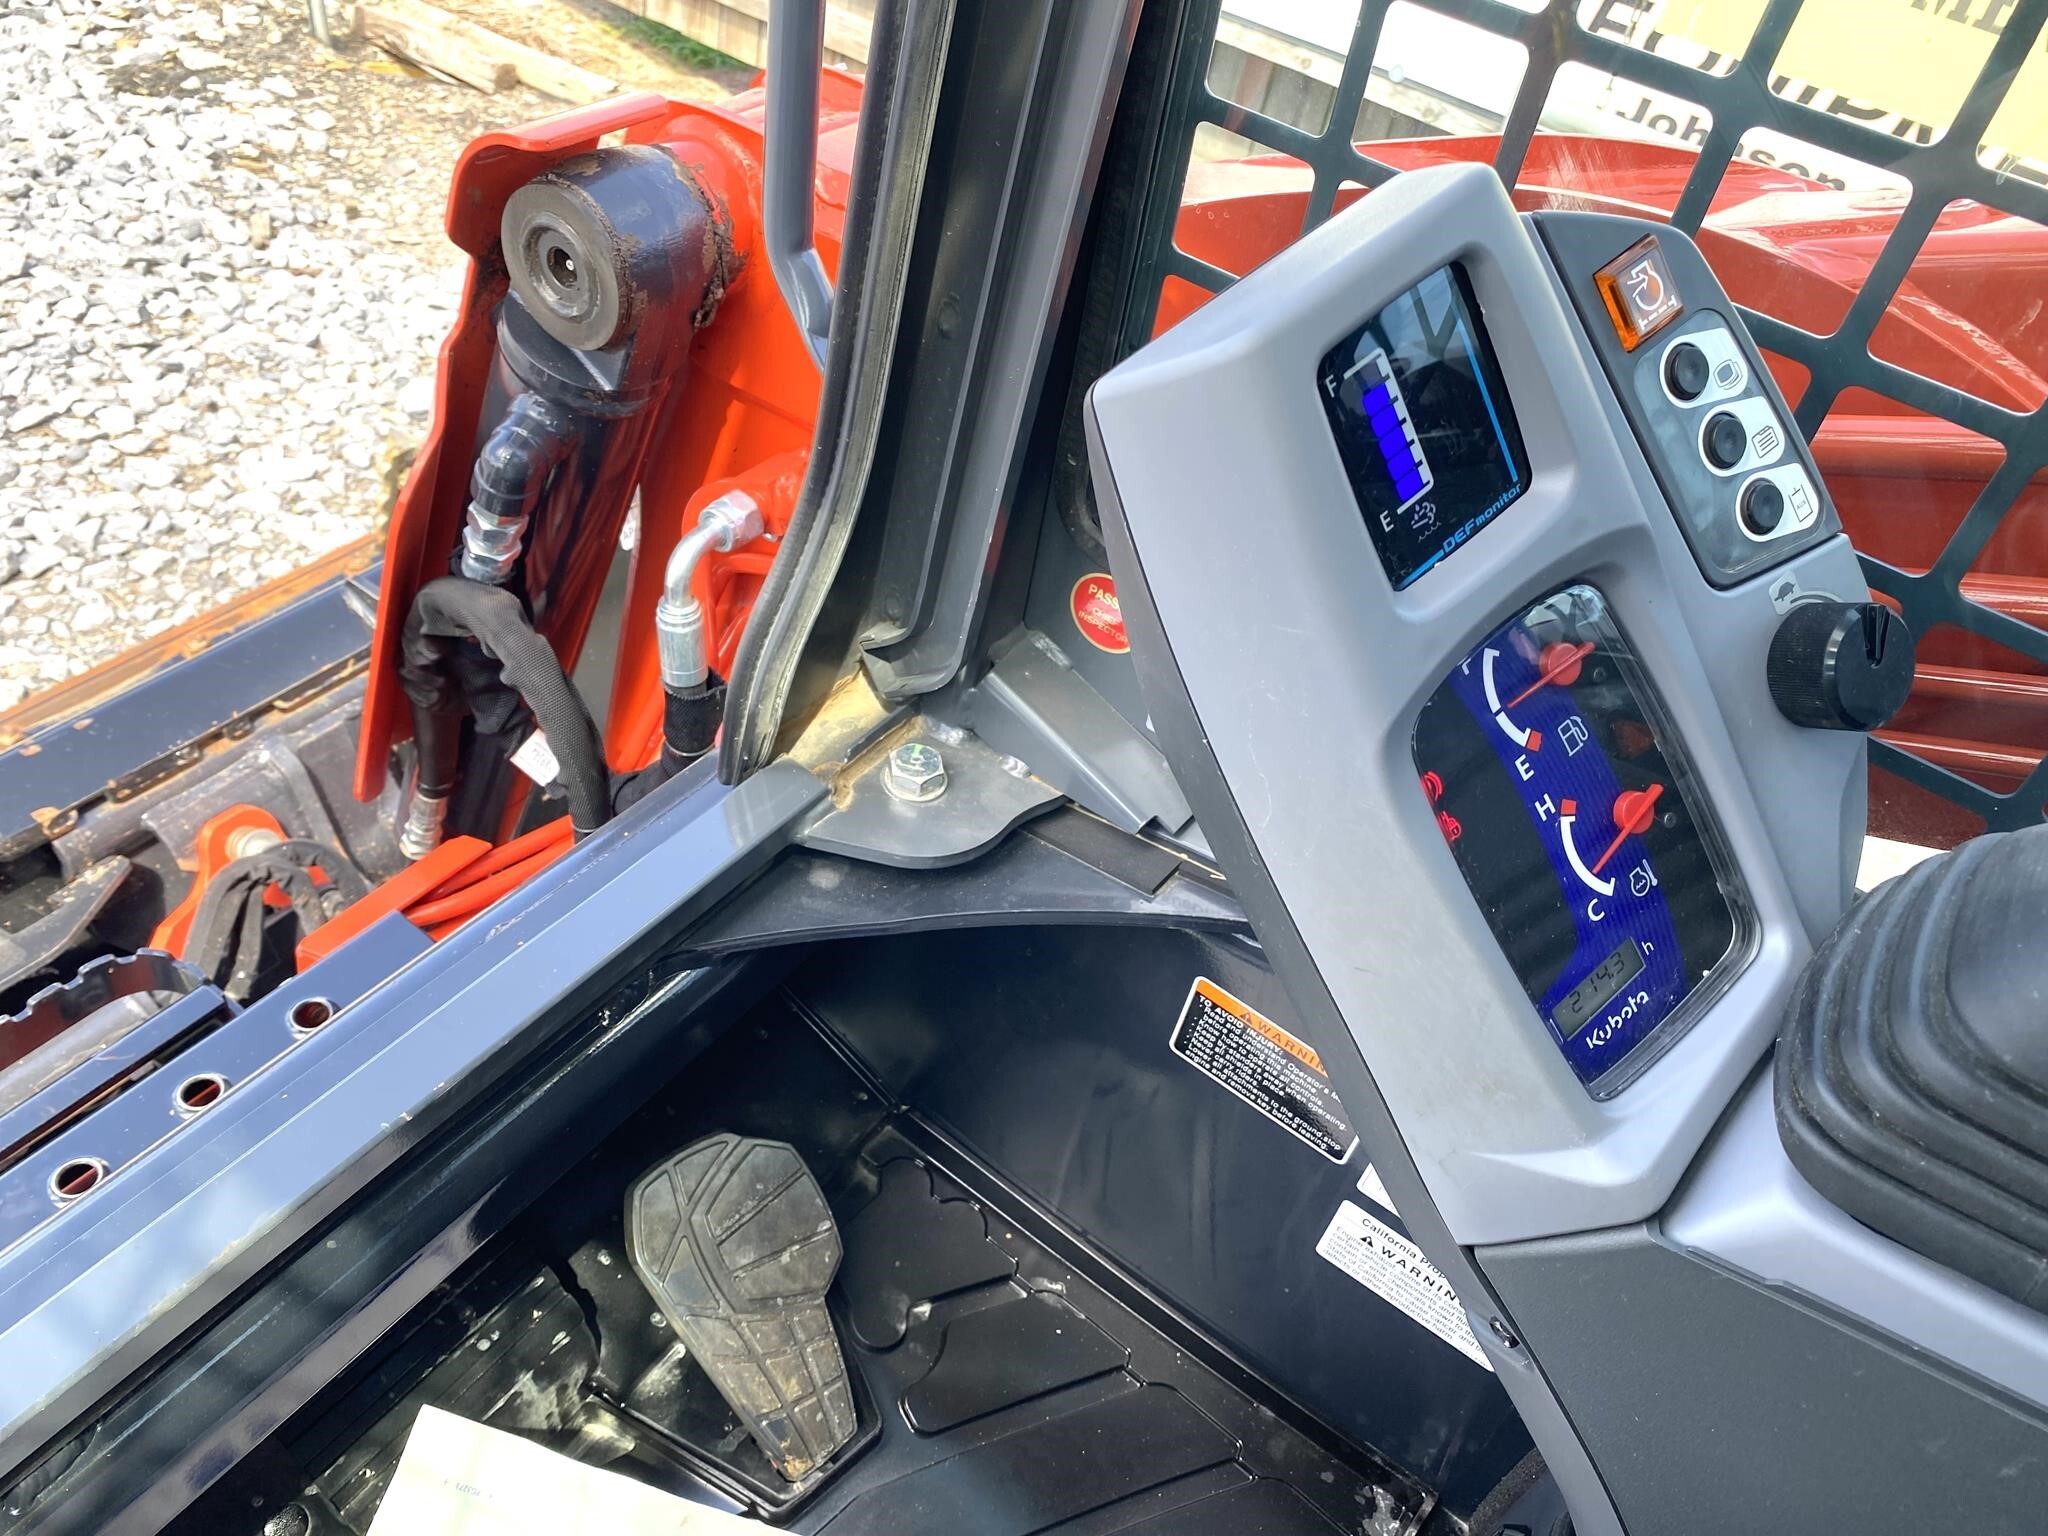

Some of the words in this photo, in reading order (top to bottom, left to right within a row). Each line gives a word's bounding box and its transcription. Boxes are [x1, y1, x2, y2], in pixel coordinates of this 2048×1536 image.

[1325, 374, 1337, 398] F
[1379, 510, 1394, 533] E
[1514, 754, 1535, 782] E
[1534, 793, 1556, 822] H
[1587, 898, 1605, 922] C
[1569, 952, 1625, 1014] 214.3
[1641, 941, 1655, 956] h
[1199, 995, 1211, 1007] TO
[1215, 1006, 1243, 1028] AVOID
[1247, 1027, 1282, 1055] INJURY:
[1203, 1014, 1227, 1034] before
[1229, 1032, 1265, 1060] operating
[1267, 1057, 1281, 1070] this
[1585, 991, 1650, 1050] Kubota
[1191, 1037, 1212, 1055] Never
[1214, 1054, 1233, 1070] carry
[1236, 1068, 1259, 1087] riders.
[1193, 1032, 1212, 1048] Keep
[1215, 1046, 1223, 1055] all
[1225, 1053, 1251, 1074] shields
[1254, 1073, 1261, 1081] in
[1263, 1079, 1285, 1098] place.
[1196, 1025, 1215, 1042] Keep
[1218, 1040, 1260, 1073] by-standers
[1263, 1071, 1283, 1089] away
[1285, 1085, 1306, 1103] when
[1307, 1101, 1347, 1132] operating.
[1199, 1019, 1219, 1036] Know
[1221, 1034, 1236, 1048] how
[1239, 1046, 1246, 1054] to
[1248, 1053, 1277, 1076] operate
[1279, 1073, 1288, 1083] all
[1291, 1081, 1324, 1107] controls.
[1204, 1007, 1224, 1023] Read
[1226, 1022, 1240, 1034] and
[1242, 1032, 1285, 1065] understand
[1287, 1062, 1328, 1095] Operator's
[1185, 1049, 1209, 1069] engine
[1212, 1067, 1225, 1079] and
[1227, 1078, 1254, 1099] remove
[1257, 1098, 1270, 1110] key
[1272, 1108, 1297, 1128] before
[1298, 1126, 1329, 1151] leaving.
[1188, 1043, 1210, 1061] Lower
[1212, 1060, 1221, 1069] all
[1223, 1067, 1268, 1101] attachments
[1271, 1100, 1278, 1108] to
[1280, 1106, 1292, 1117] the
[1336, 1227, 1363, 1247] Engine
[1362, 1218, 1416, 1257] California
[1357, 1264, 1394, 1291] California
[1404, 1297, 1427, 1315] cause
[1429, 1314, 1456, 1334] cancer
[1458, 1333, 1474, 1346] and
[1361, 1251, 1387, 1271] vehicle
[1389, 1271, 1437, 1305] components
[1439, 1304, 1453, 1316] and
[1362, 1275, 1381, 1289] other
[1383, 1290, 1430, 1324] reproductive
[1387, 1277, 1426, 1305] chemicals
[1427, 1304, 1453, 1323] known
